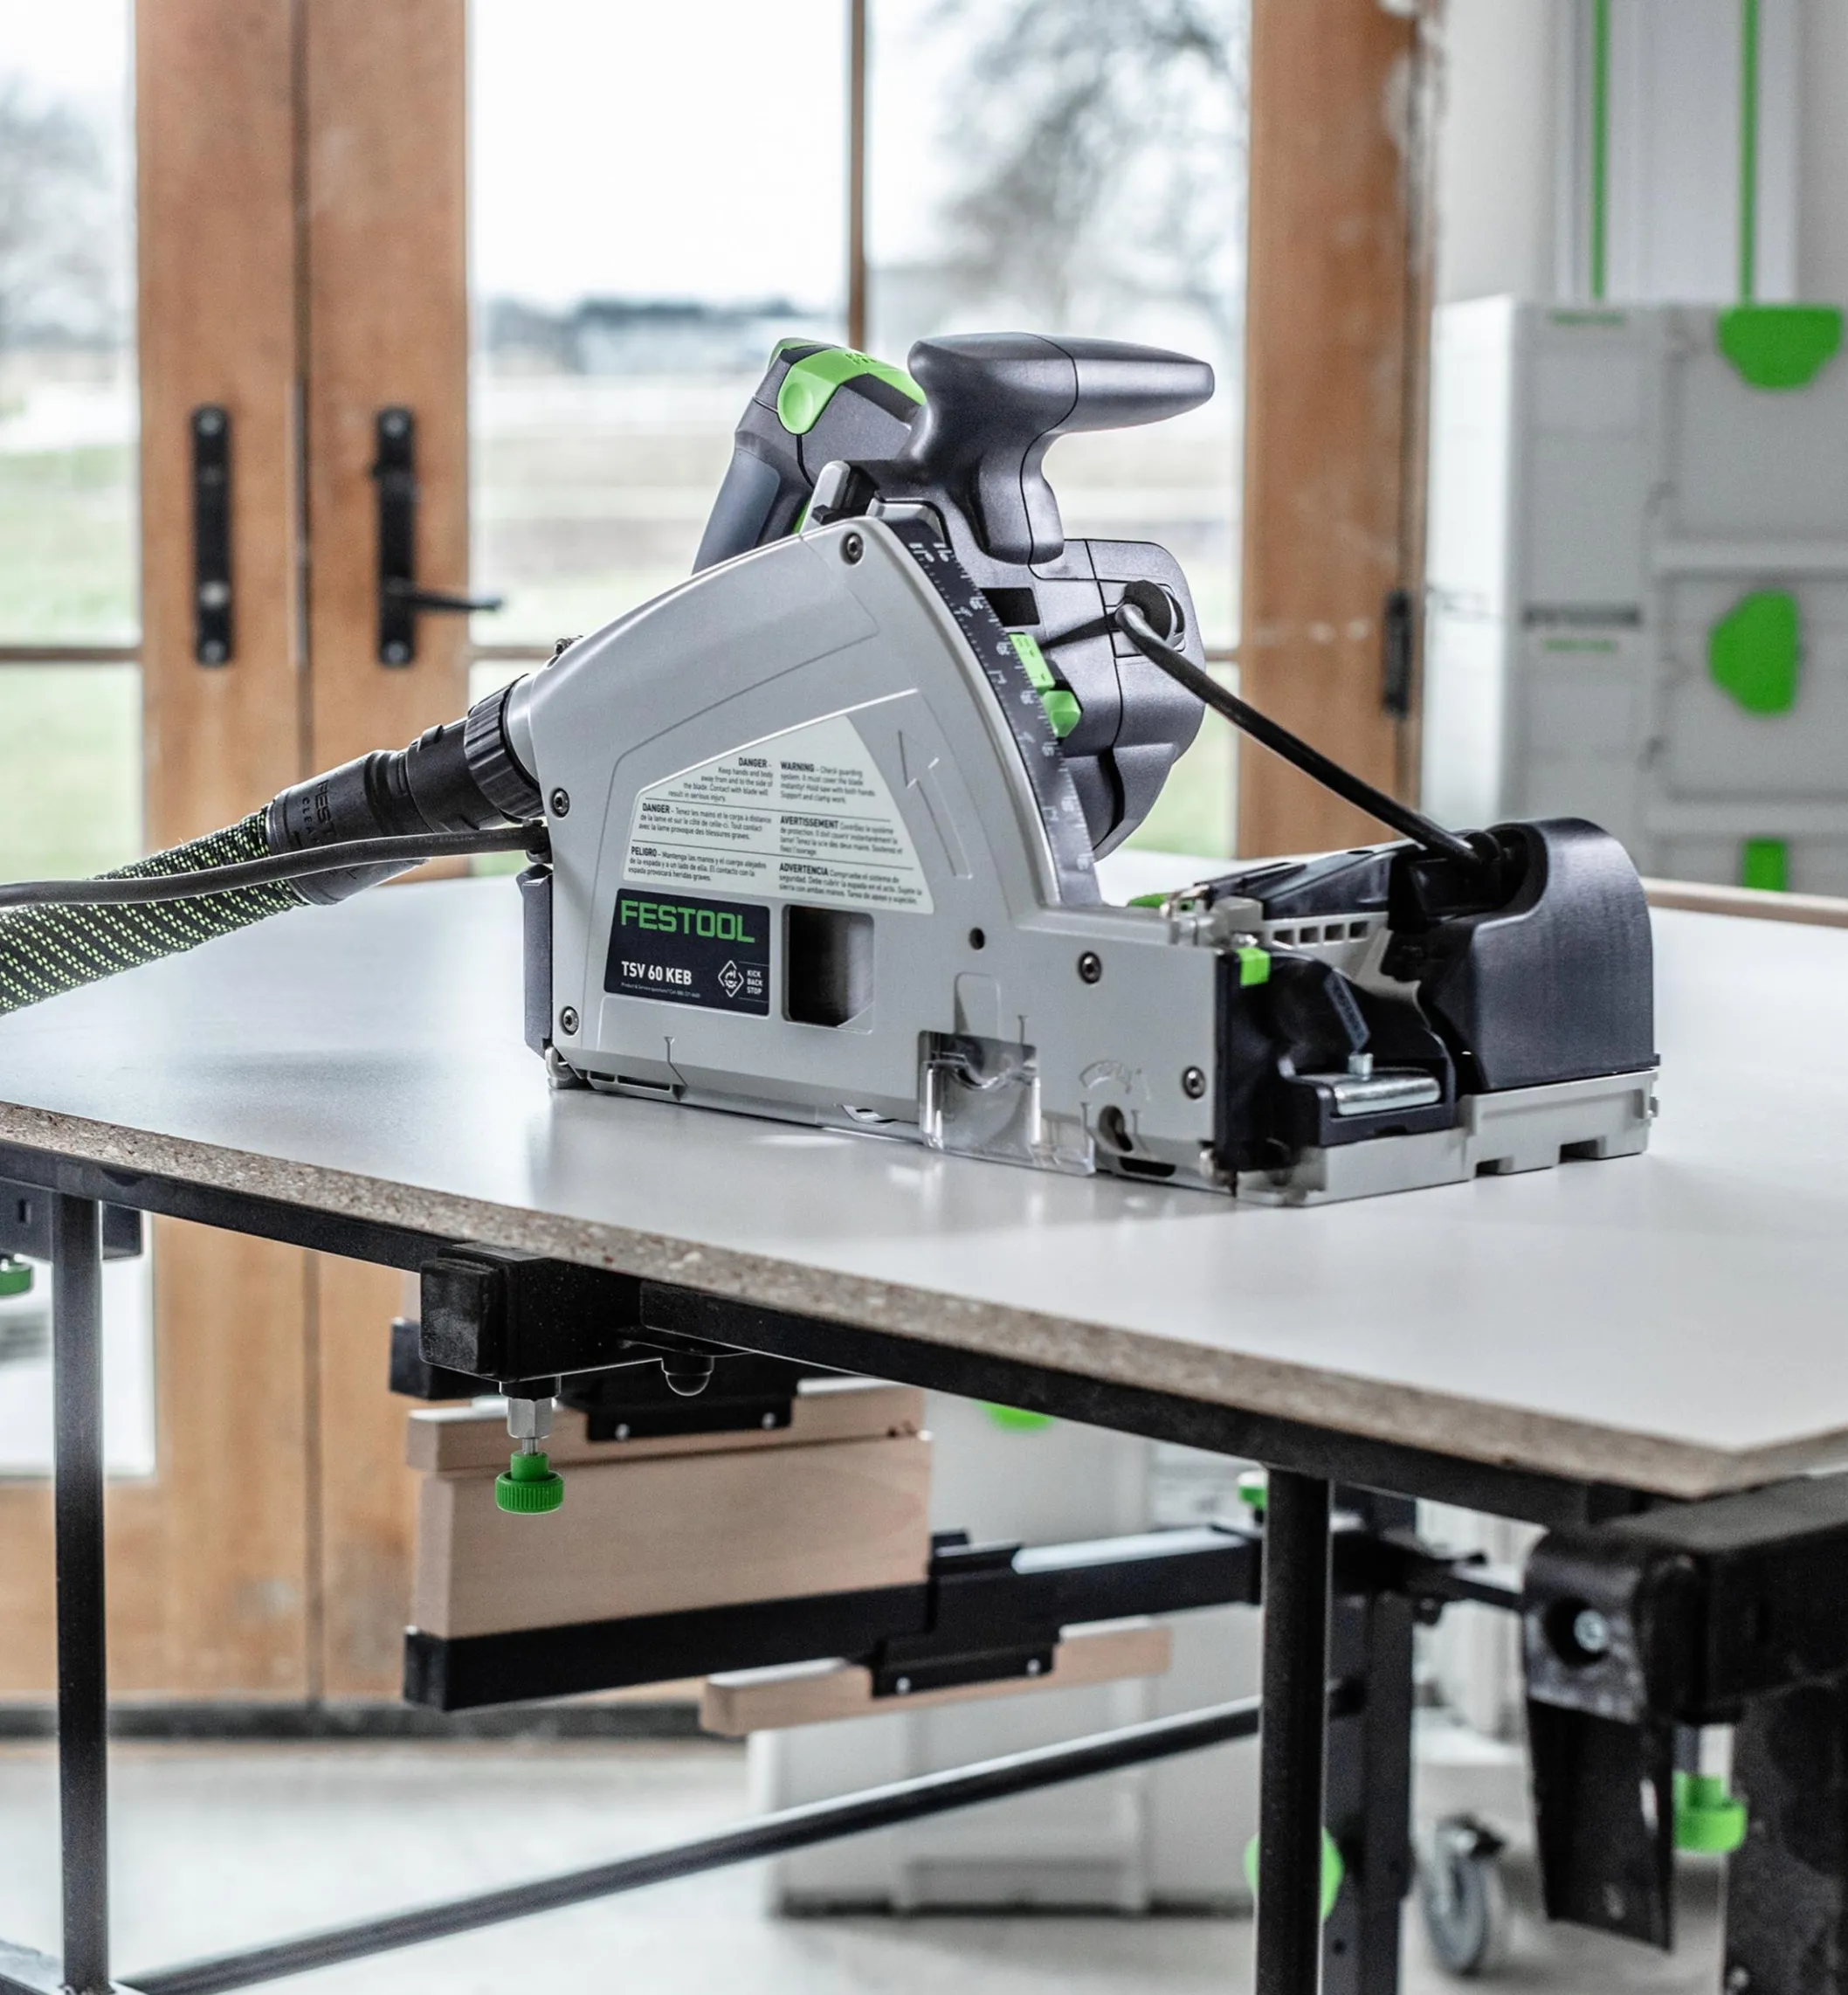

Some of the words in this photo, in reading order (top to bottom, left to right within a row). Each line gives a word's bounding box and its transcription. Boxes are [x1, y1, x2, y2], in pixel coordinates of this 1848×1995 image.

[739, 756, 769, 769] DANGER
[781, 761, 814, 773] WARNING
[733, 768, 748, 777] hands
[714, 776, 727, 784] from
[709, 784, 730, 793] Contact
[742, 787, 757, 796] blade
[643, 803, 670, 814] DANGER
[781, 815, 838, 830] AVERTISSEMENT
[631, 846, 657, 858] PELIGRO
[780, 862, 828, 876] ADVERTENCIA
[621, 900, 755, 943] FESTOOL
[621, 961, 646, 978] TSV
[648, 965, 664, 982] 60
[665, 967, 693, 985] KEB
[747, 970, 762, 978] KICK
[747, 977, 763, 987] BACK
[747, 986, 762, 996] STOP
